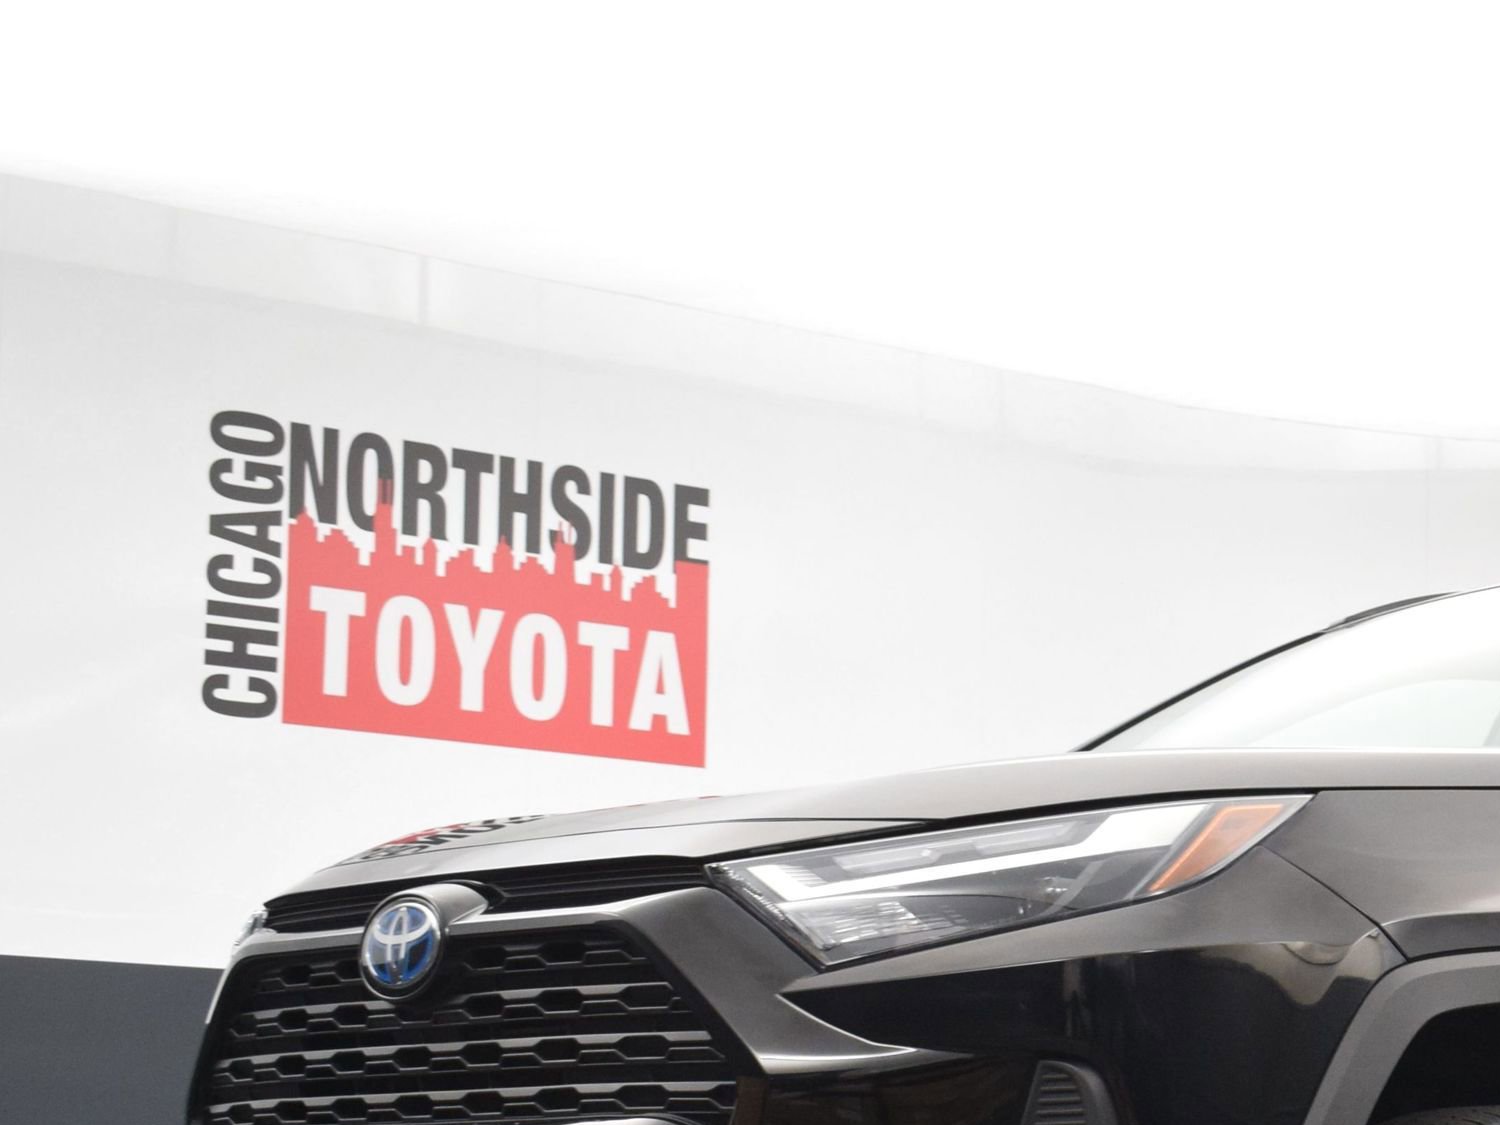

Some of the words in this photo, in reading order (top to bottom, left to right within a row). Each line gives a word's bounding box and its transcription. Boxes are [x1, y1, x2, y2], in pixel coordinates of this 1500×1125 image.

[201, 410, 286, 719] CHICAGO
[289, 422, 710, 569] NORTHSIDE
[309, 585, 691, 736] TOYOTA
